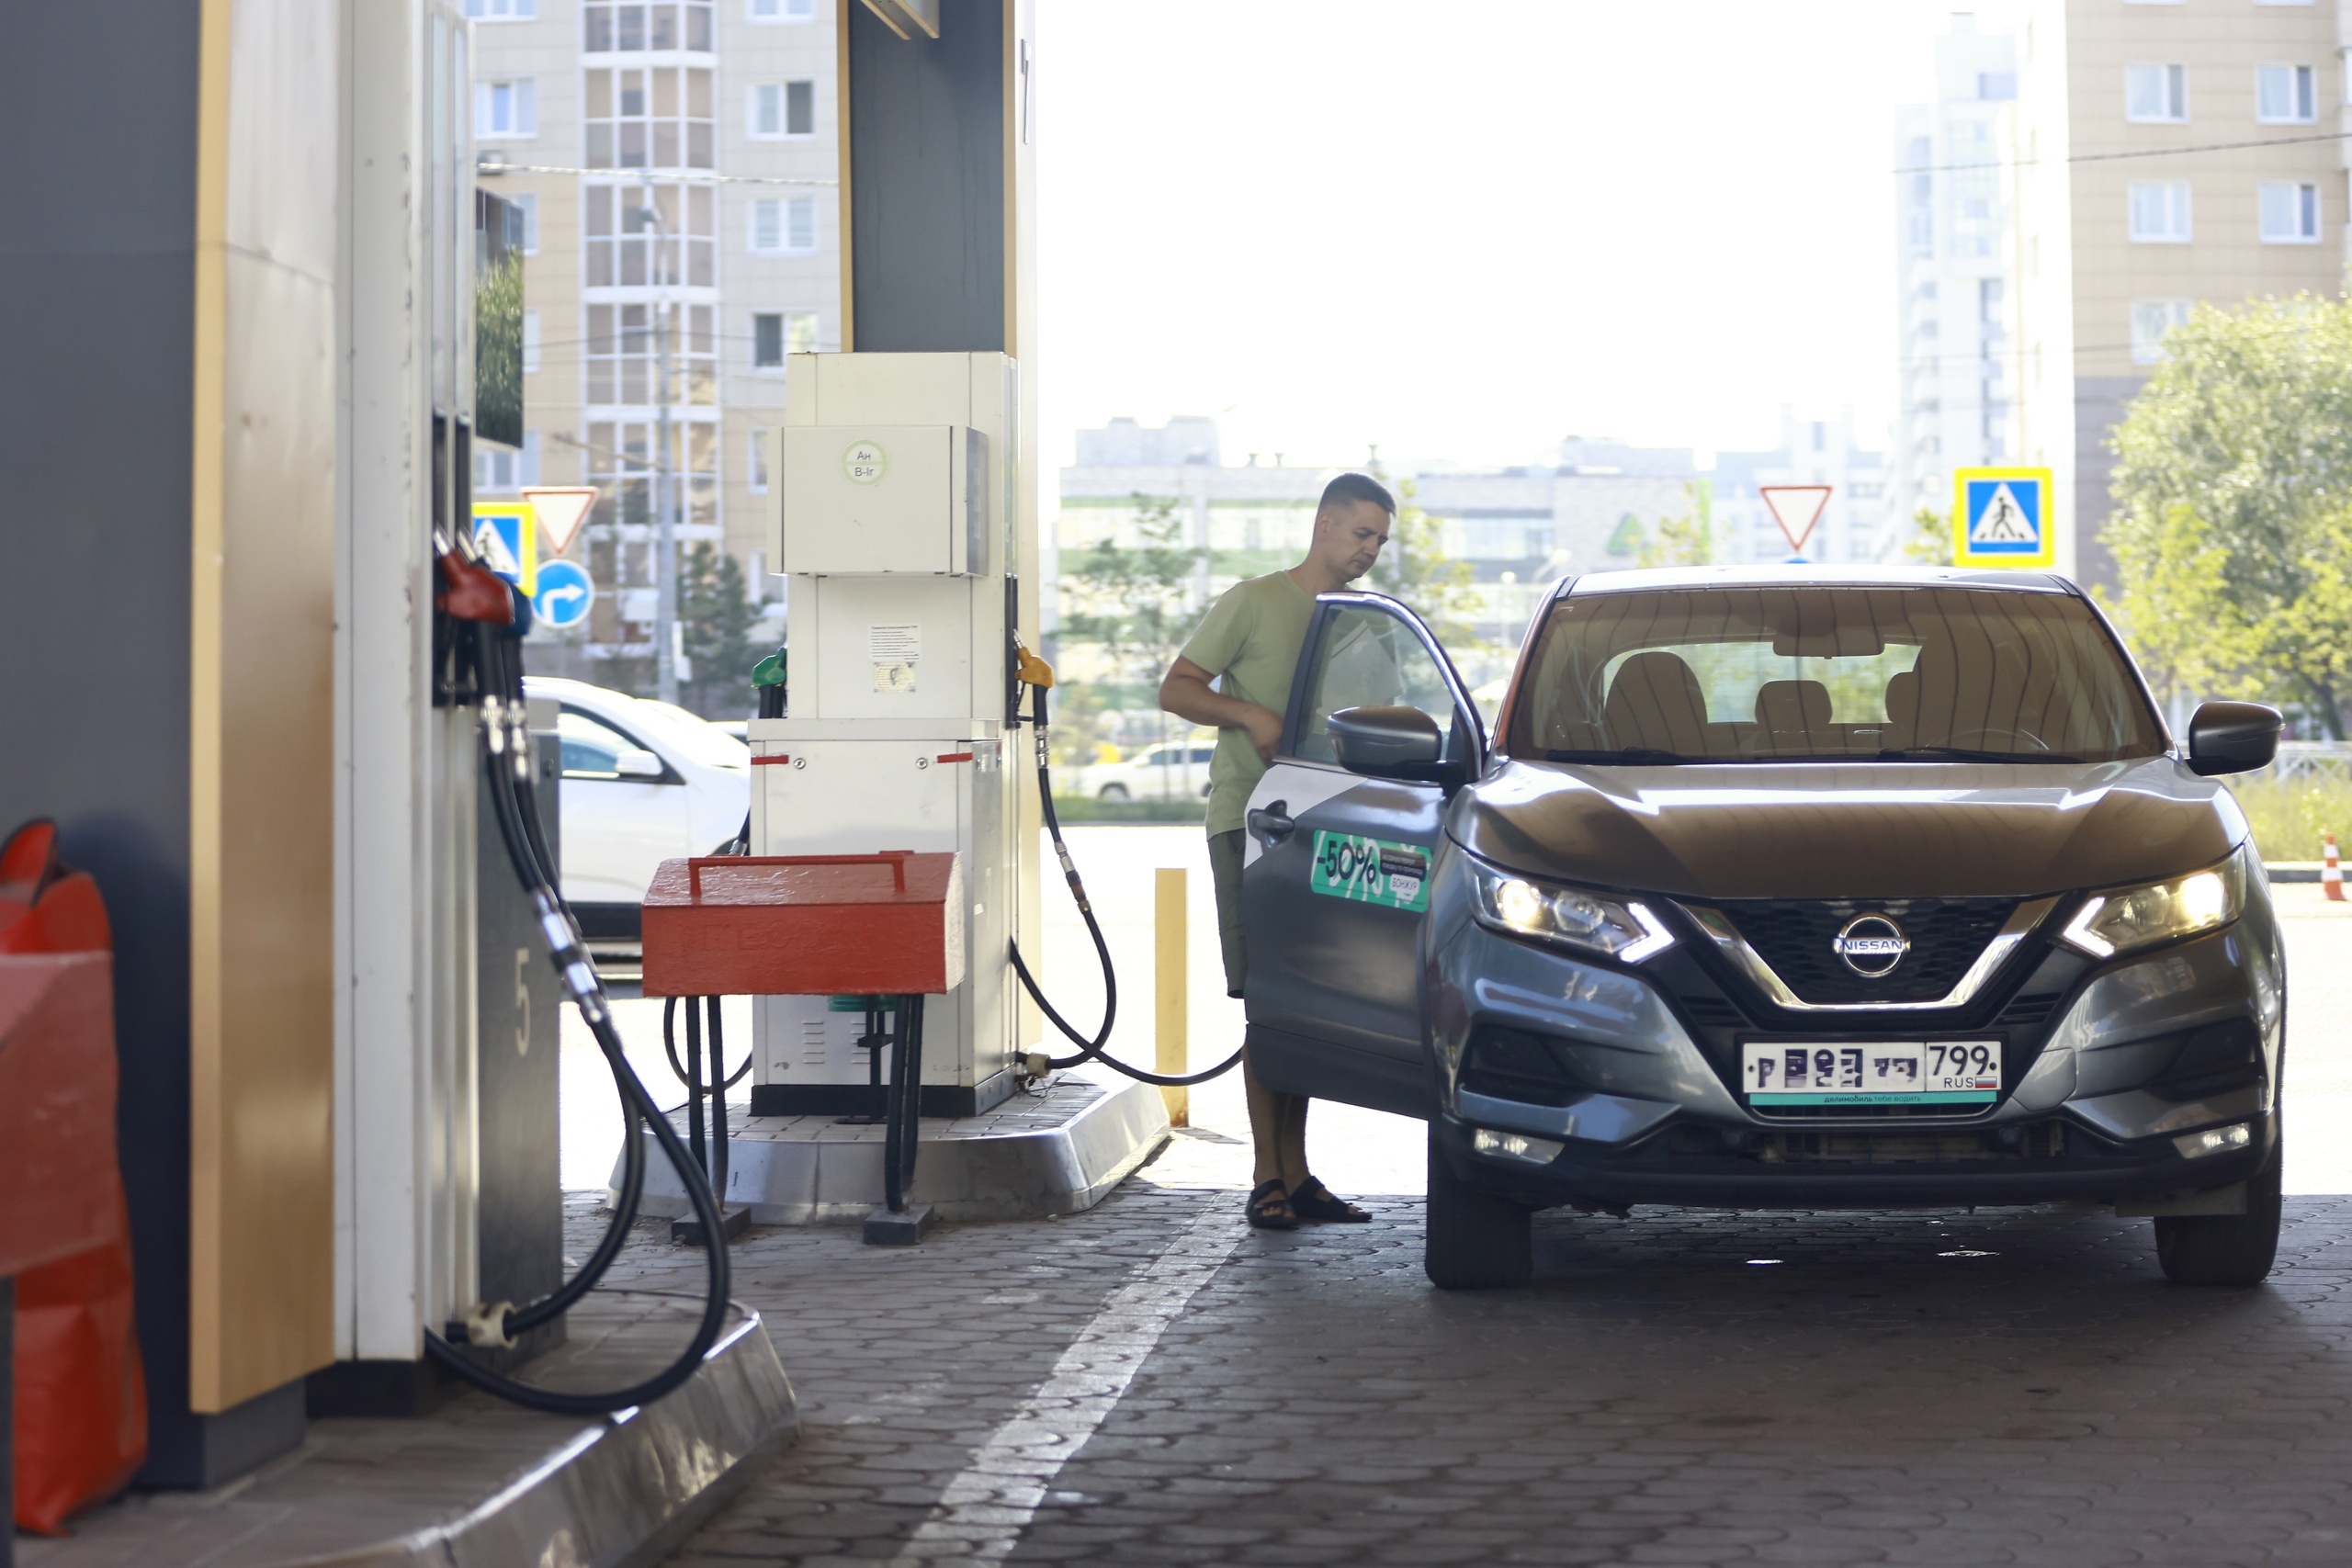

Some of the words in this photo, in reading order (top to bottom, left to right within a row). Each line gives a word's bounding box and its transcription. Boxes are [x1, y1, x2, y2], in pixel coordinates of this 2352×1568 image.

[1317, 840, 1377, 885] -50%
[1391, 876, 1418, 891] БОНЖУР
[1841, 939, 1904, 951] NISSAN
[515, 947, 531, 1056] 5
[1928, 1044, 1991, 1077] 799
[1943, 1077, 1974, 1089] RUS
[1824, 1095, 1873, 1103] делимобиль
[1894, 1095, 1922, 1103] водить
